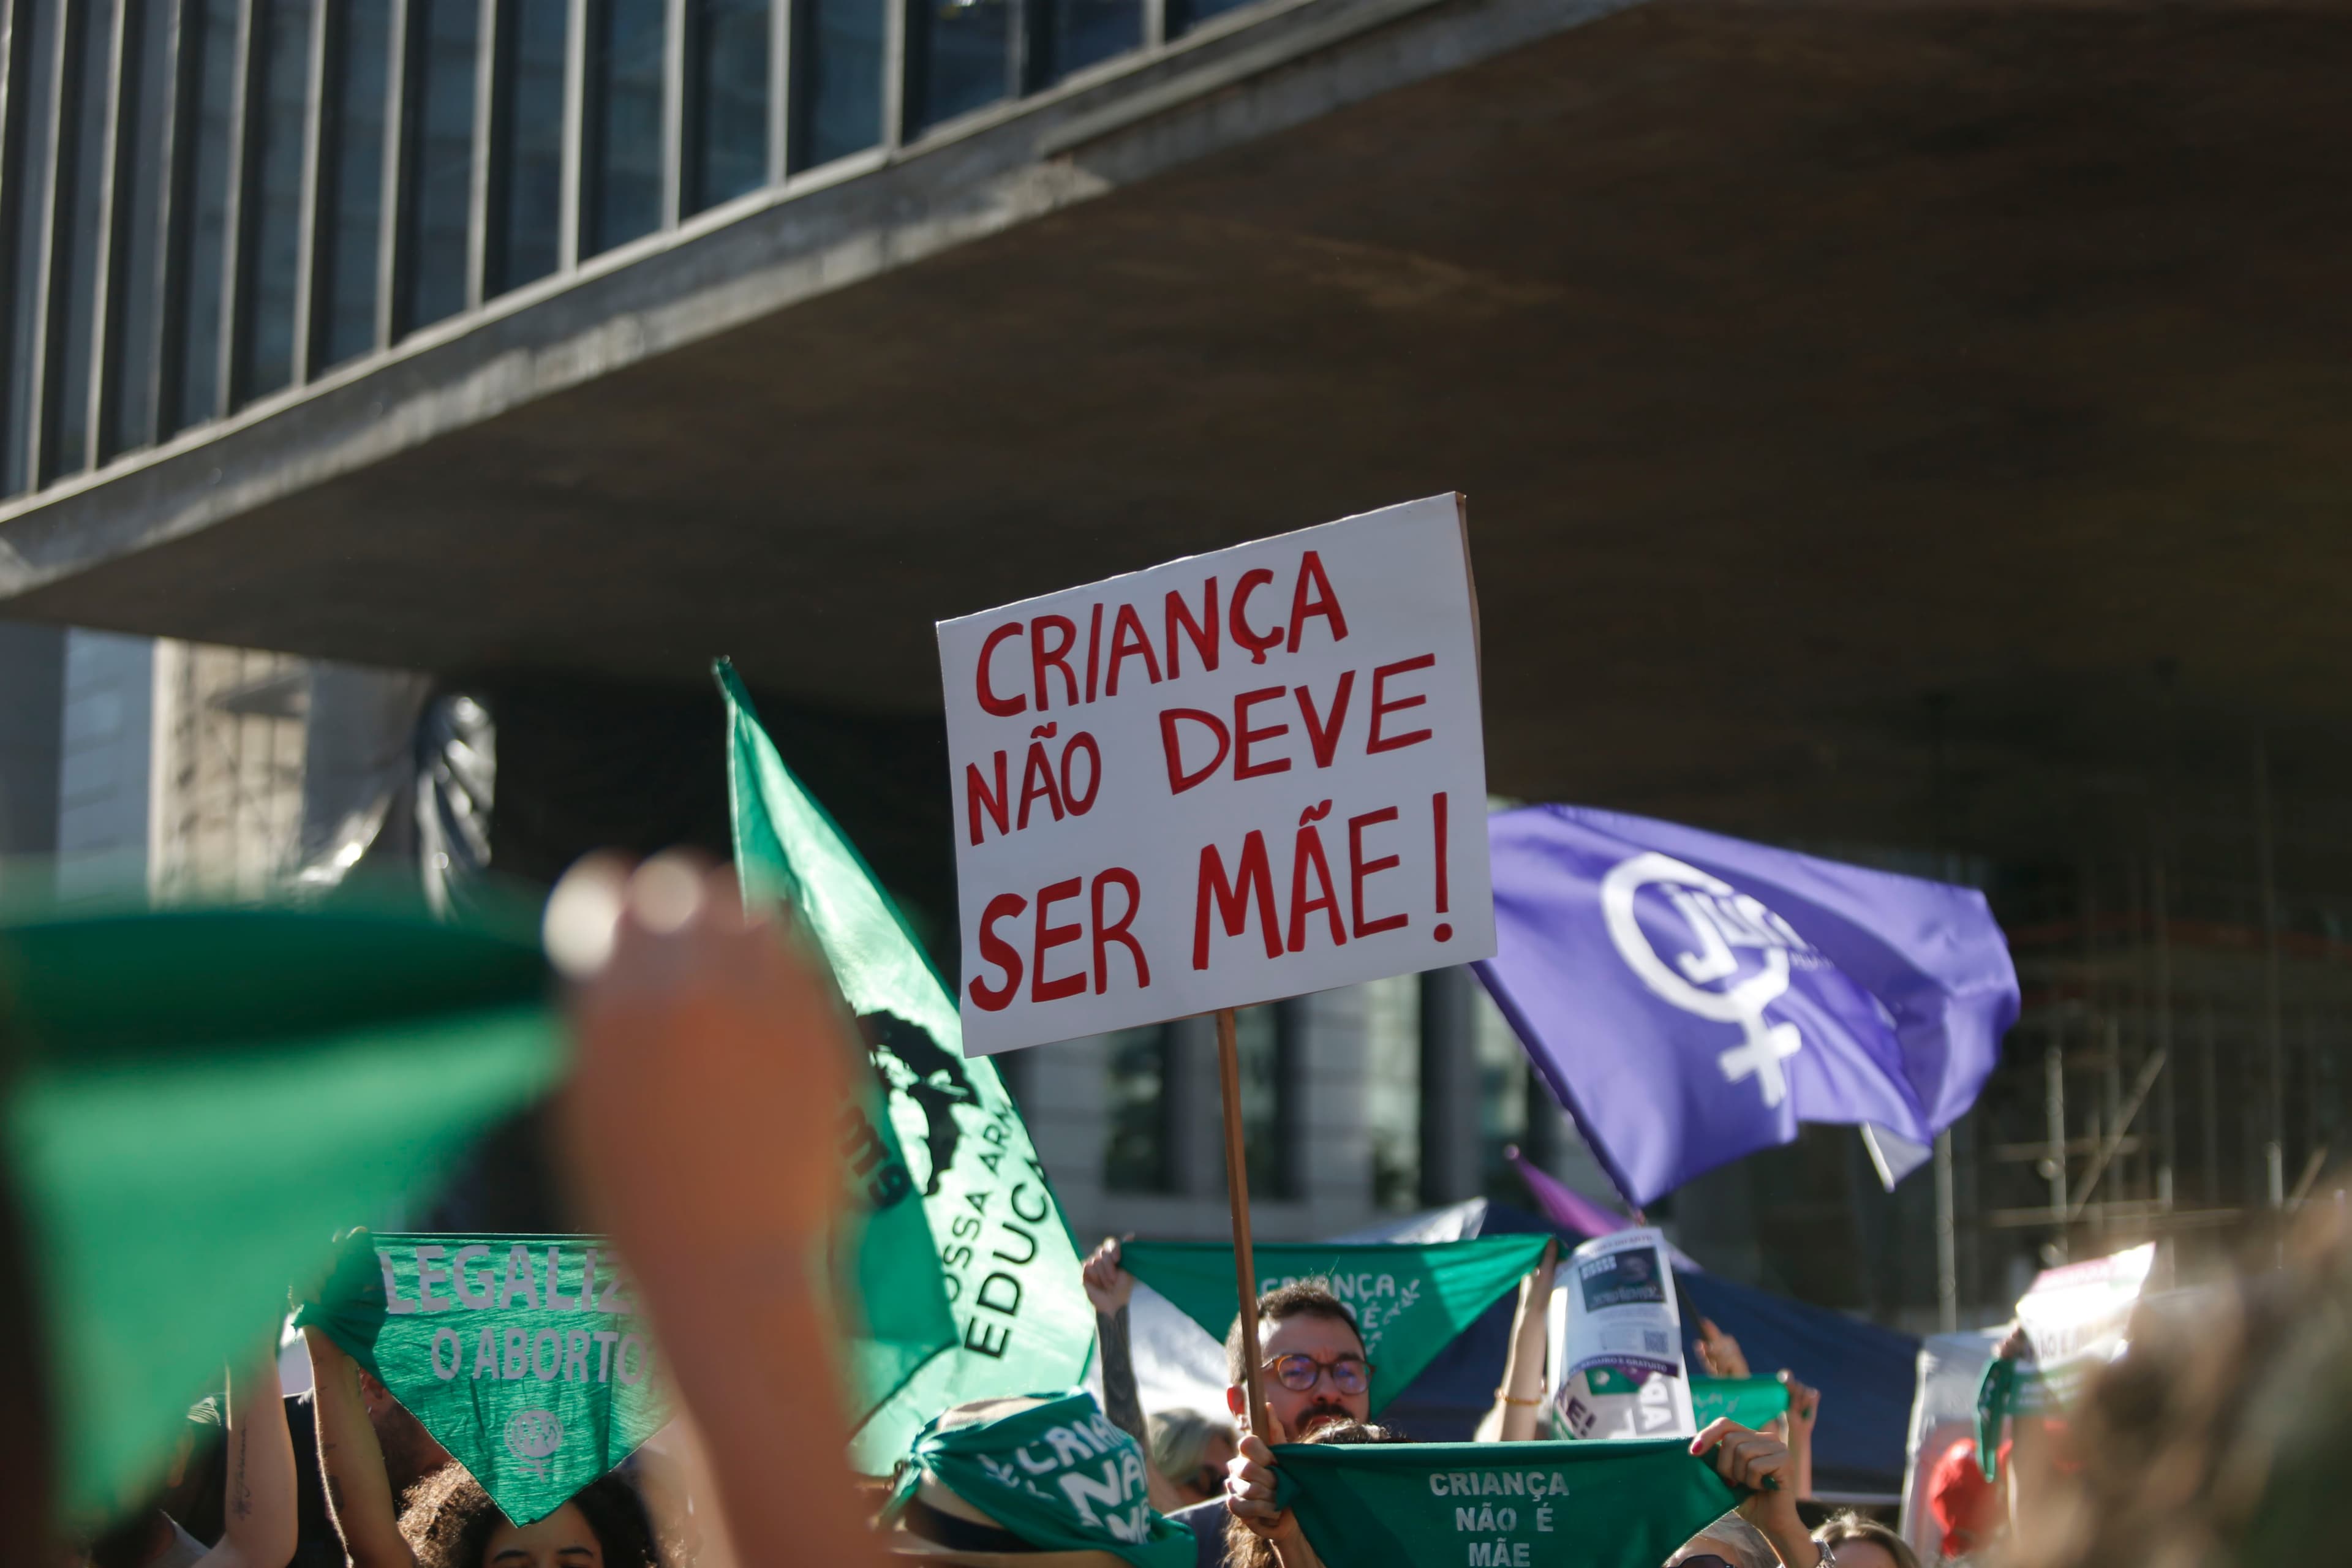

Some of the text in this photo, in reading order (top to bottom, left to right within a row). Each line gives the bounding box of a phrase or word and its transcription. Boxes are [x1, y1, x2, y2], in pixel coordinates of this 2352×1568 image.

[976, 551, 1348, 717] CRIANÇA
[966, 653, 1435, 846] NÃO DEVE
[969, 792, 1453, 1011] SER MÃE!
[431, 1327, 647, 1385] O ABORTO
[1430, 1472, 1569, 1501] CRIANÇA
[1456, 1502, 1553, 1531] NÃO É
[1469, 1537, 1531, 1567] MÃE
